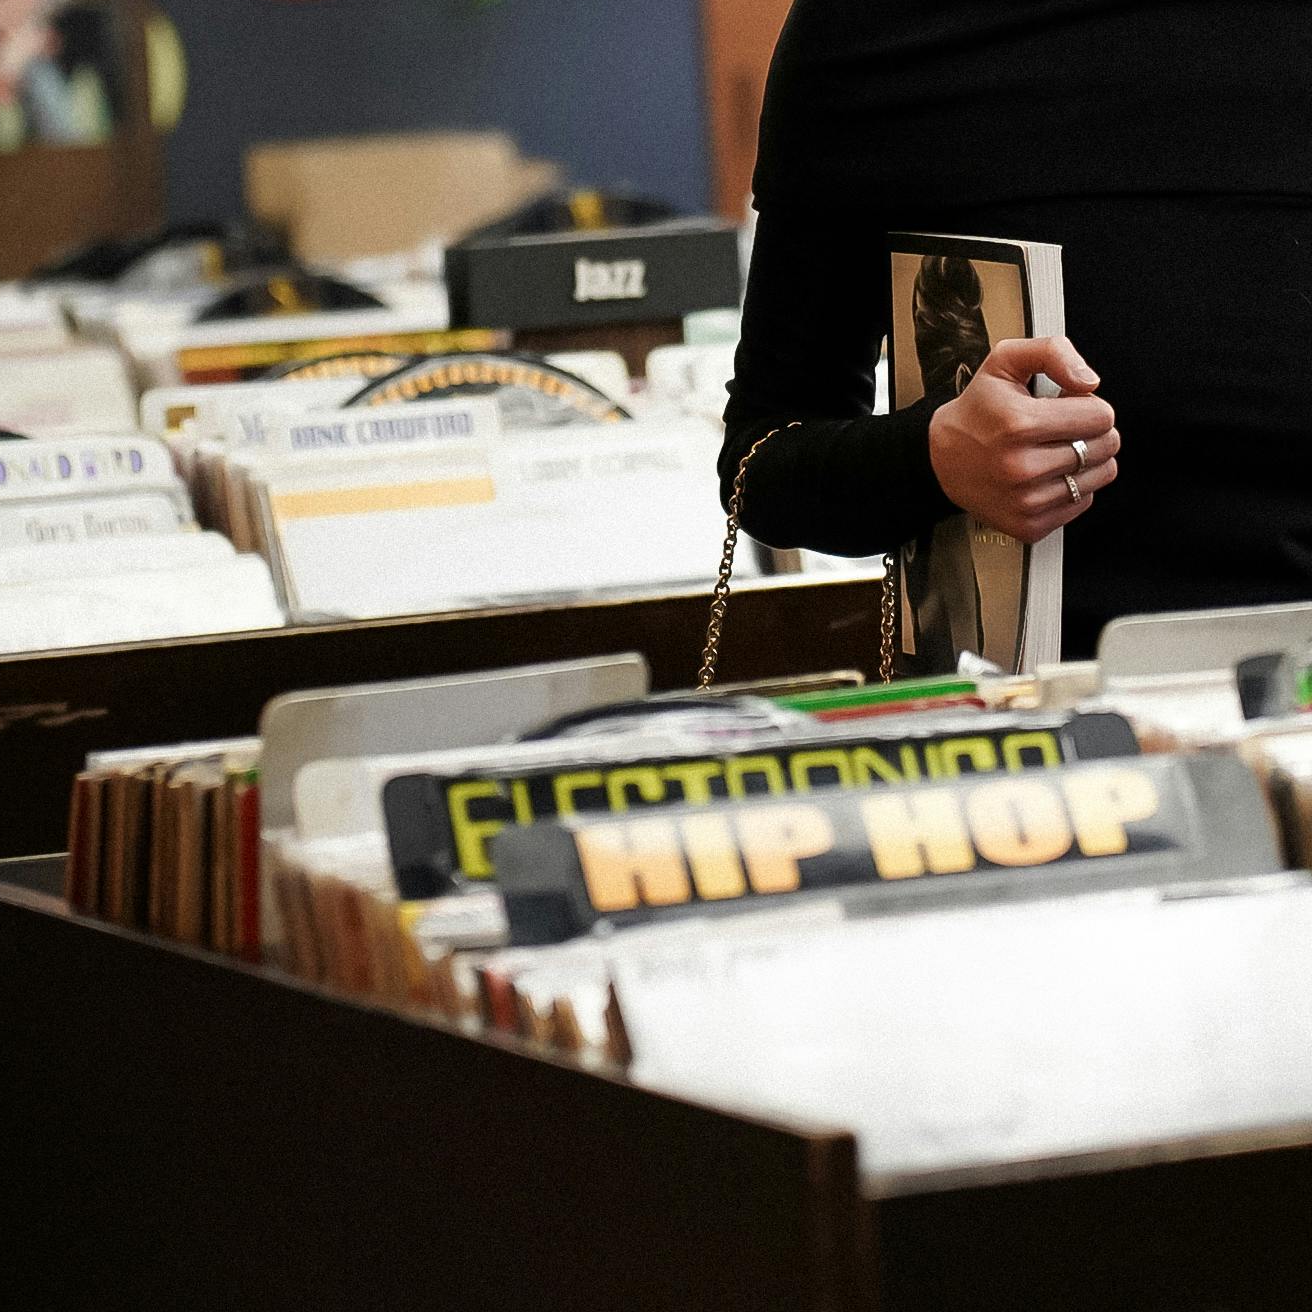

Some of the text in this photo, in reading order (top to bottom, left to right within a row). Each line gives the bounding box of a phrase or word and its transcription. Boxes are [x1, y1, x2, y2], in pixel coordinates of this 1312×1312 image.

[572, 256, 647, 303] Jazz
[573, 764, 1160, 913] HIP HOP
